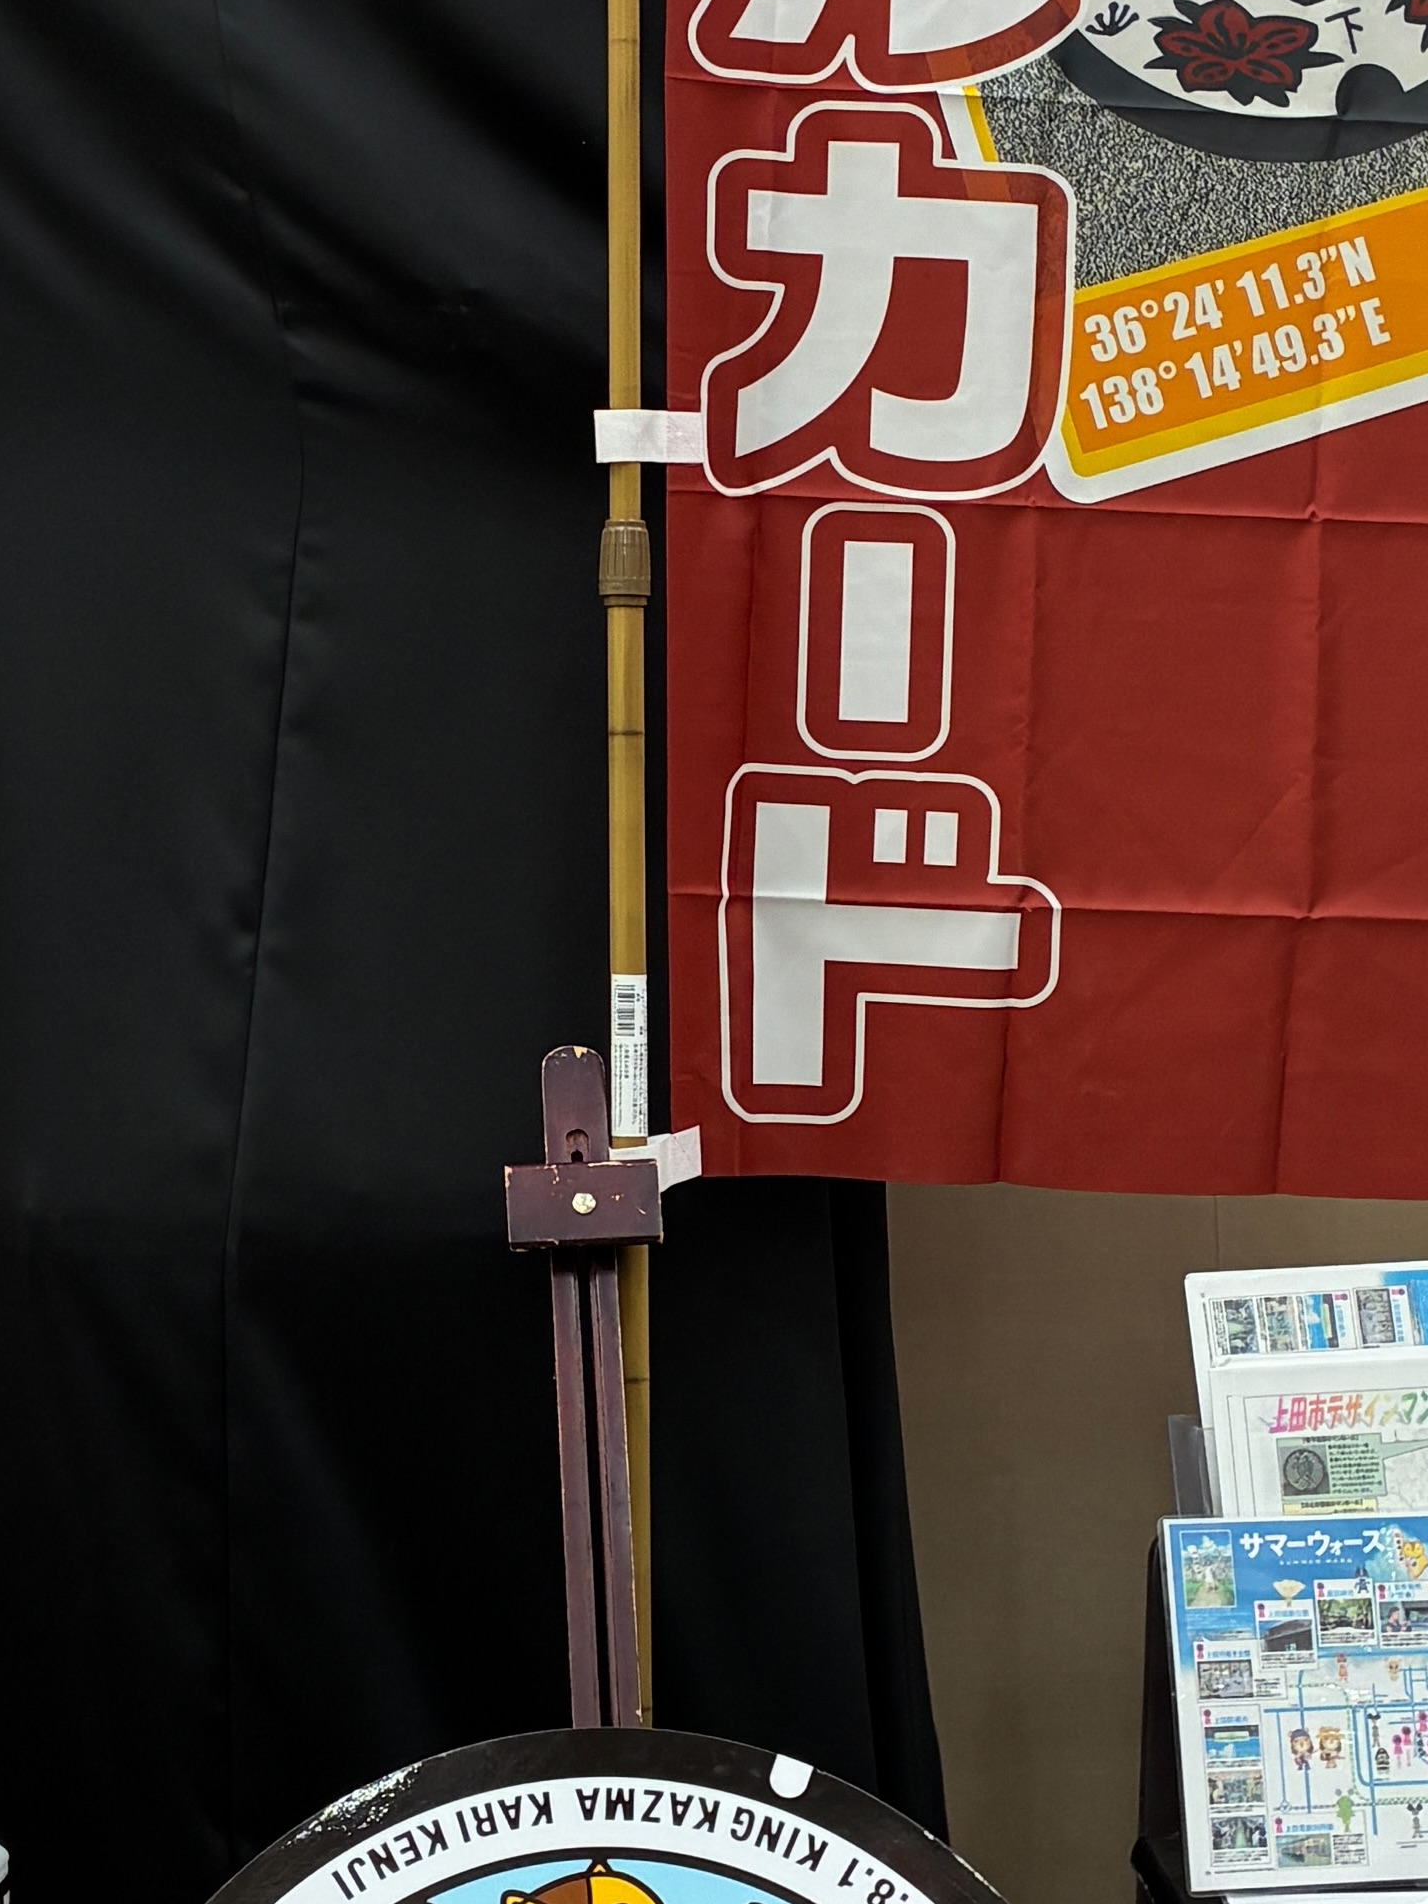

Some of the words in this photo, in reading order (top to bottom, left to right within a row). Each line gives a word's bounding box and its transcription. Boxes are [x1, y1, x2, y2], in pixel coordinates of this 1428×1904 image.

[1239, 1526, 1385, 1559] サマーウォーズ
[455, 1790, 554, 1843] KARI
[575, 1786, 721, 1834] KAZMA
[331, 1819, 450, 1901] KENJI
[729, 1807, 830, 1873] KING
